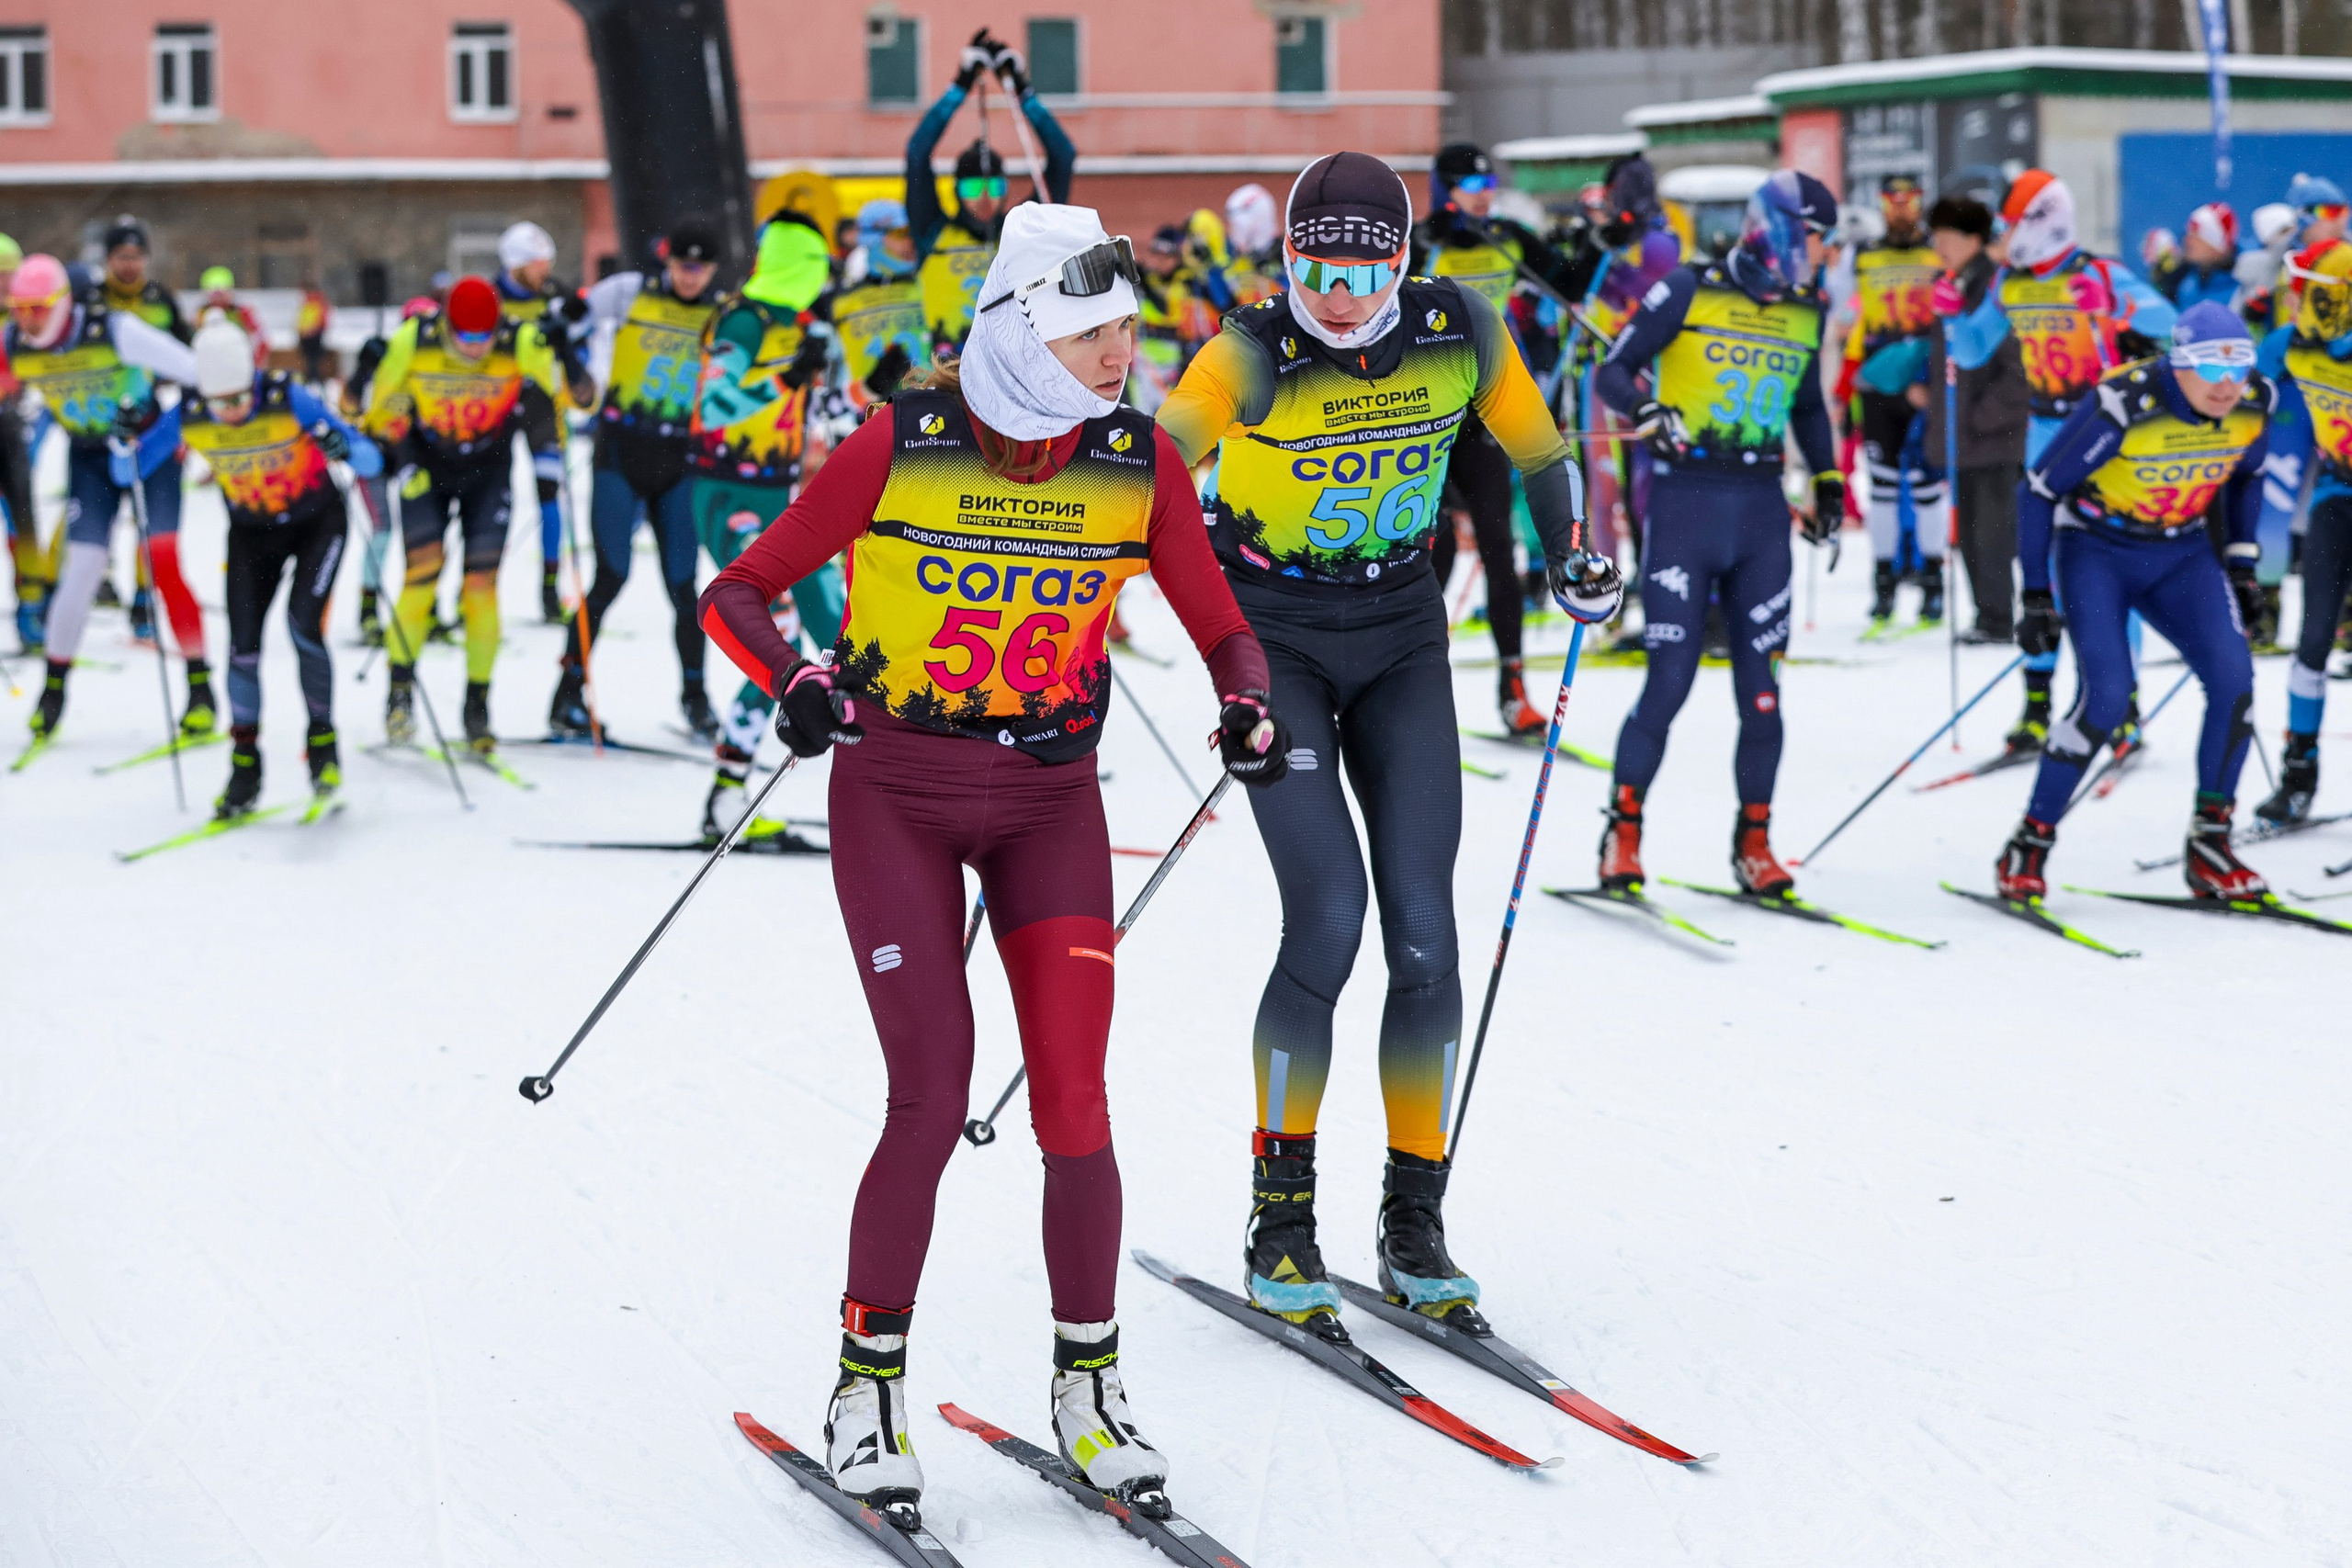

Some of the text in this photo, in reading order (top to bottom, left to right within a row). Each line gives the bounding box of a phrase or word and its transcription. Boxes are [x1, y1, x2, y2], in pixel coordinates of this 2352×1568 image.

[1323, 387, 1429, 415] ВИКТОРИЯ
[1709, 368, 1785, 426] 30
[1326, 405, 1429, 428] вместе мы строим
[1279, 433, 1356, 451] НОВОГОДНИЙ
[1358, 422, 1431, 442] КОМАНДНЫЙ
[959, 494, 1086, 519] ВИКТОРИЯ
[1305, 475, 1429, 550] 56
[959, 514, 1082, 533] вместе мы строим
[903, 525, 1121, 558] НОВОГОДНИЙ КОМАНДНЫЙ СПРИНТ
[923, 605, 1069, 694] 56
[1023, 728, 1058, 743] DIWARI
[841, 1357, 900, 1377] FISCHER
